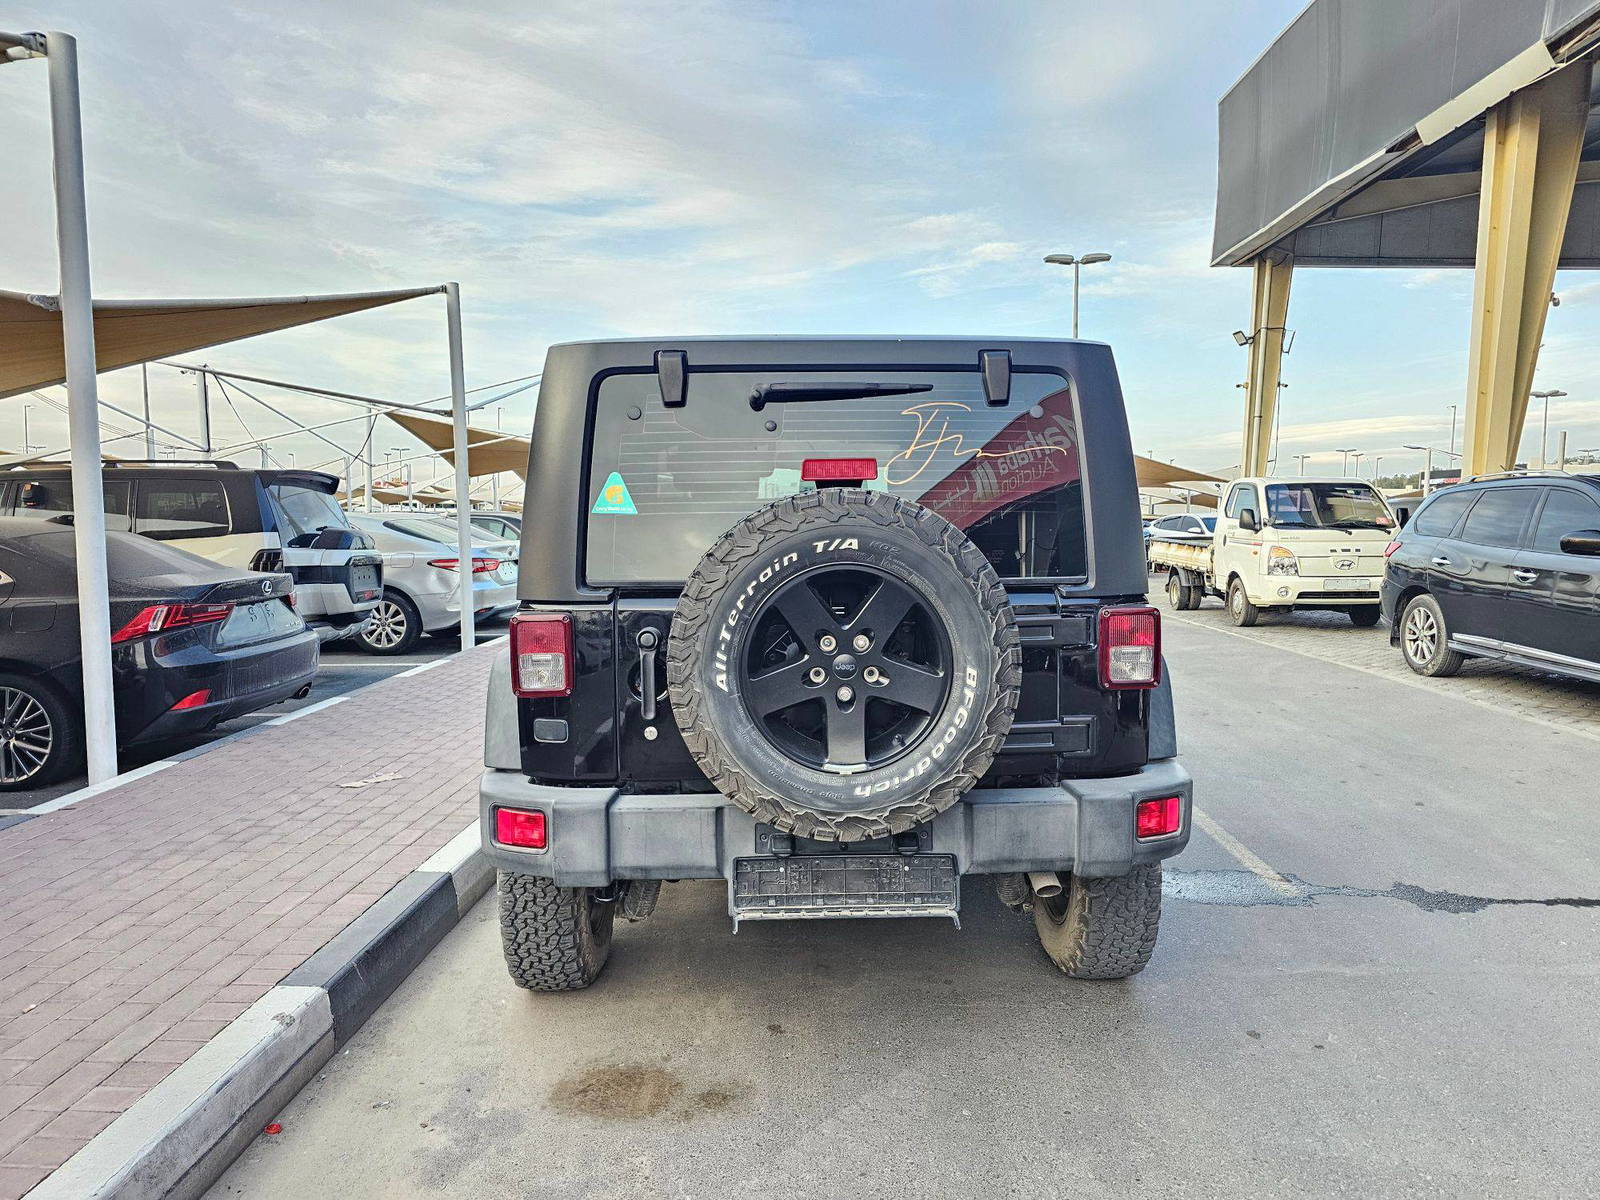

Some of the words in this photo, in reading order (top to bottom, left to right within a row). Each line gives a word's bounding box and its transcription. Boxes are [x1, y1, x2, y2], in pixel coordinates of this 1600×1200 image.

[714, 551, 799, 693] All-Terrain
[812, 538, 859, 554] T/A
[854, 666, 978, 797] BFGoodrich
